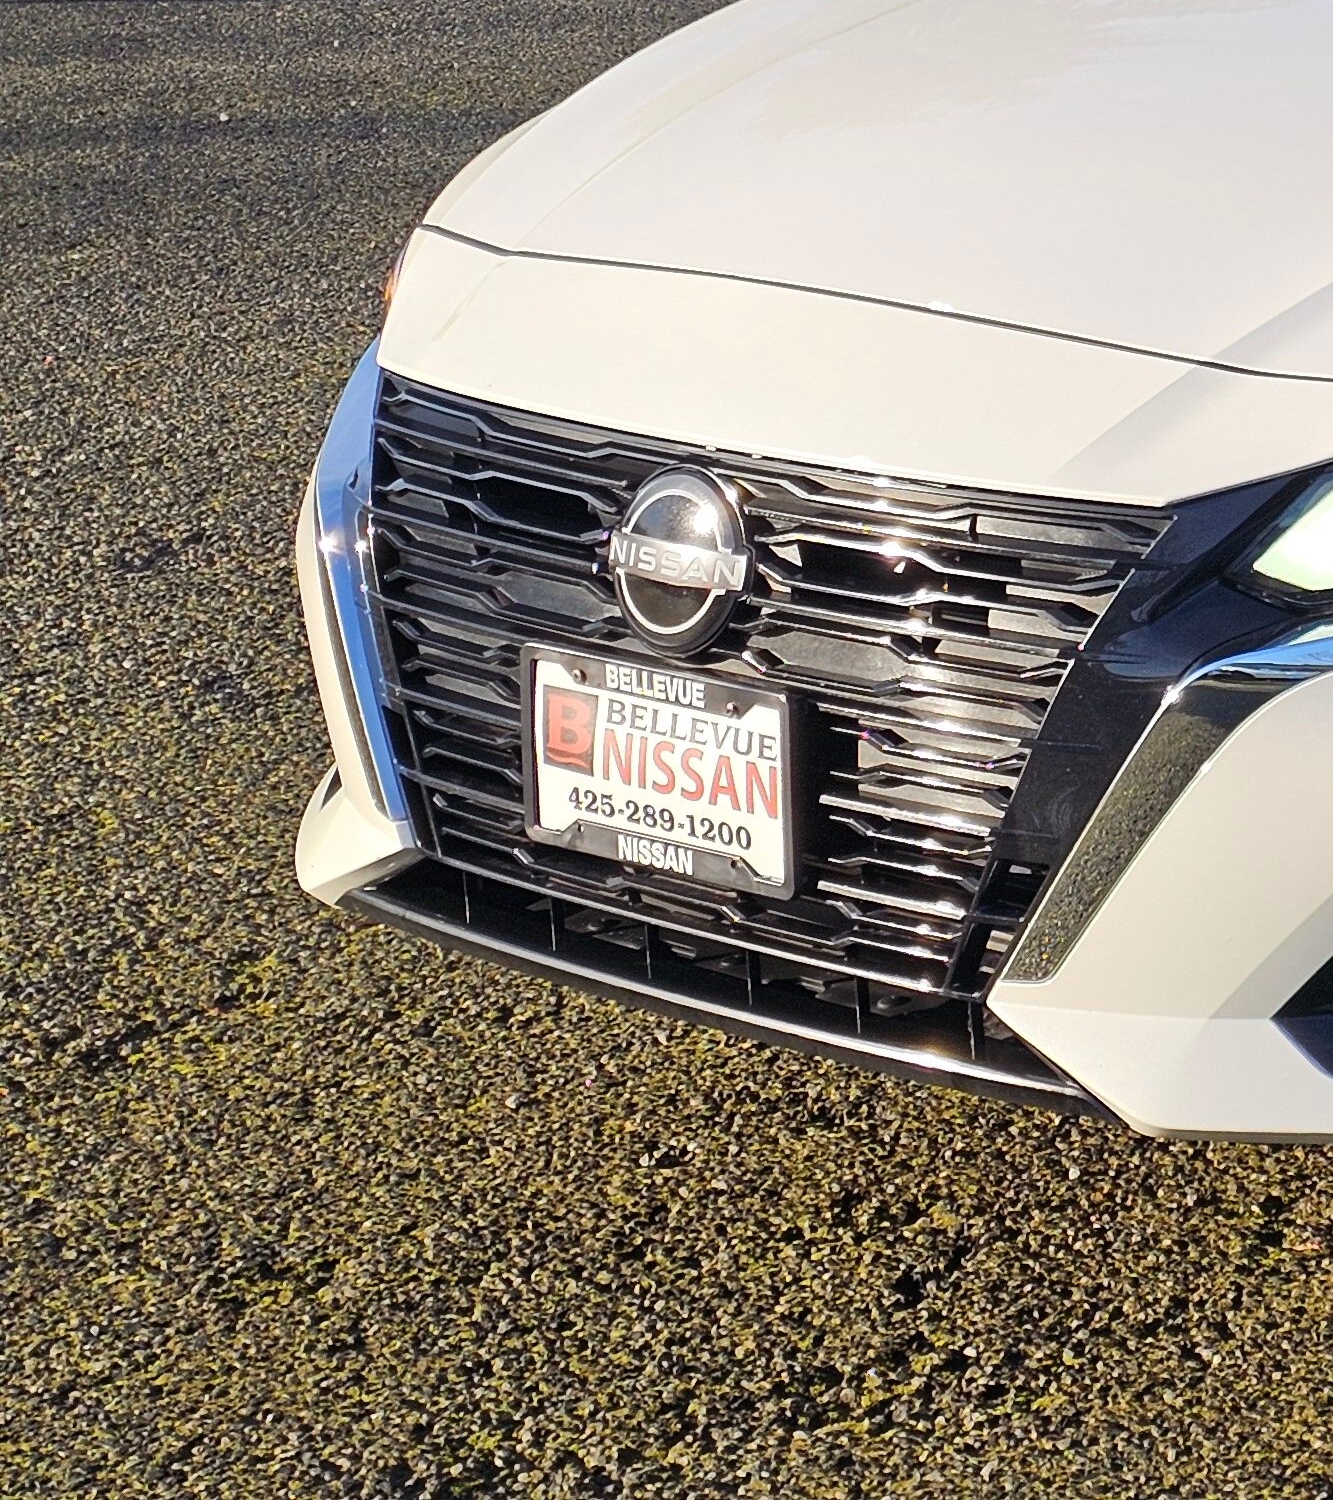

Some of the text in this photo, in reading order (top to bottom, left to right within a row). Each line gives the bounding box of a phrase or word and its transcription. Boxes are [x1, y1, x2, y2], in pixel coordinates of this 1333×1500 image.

[609, 536, 741, 587] NISSAN
[605, 663, 706, 709] BELLEVUE
[606, 698, 778, 762] BELLEVUE
[602, 728, 778, 820] NISSAN
[569, 786, 752, 851] 425-289-1200
[617, 834, 694, 876] NISSAN
